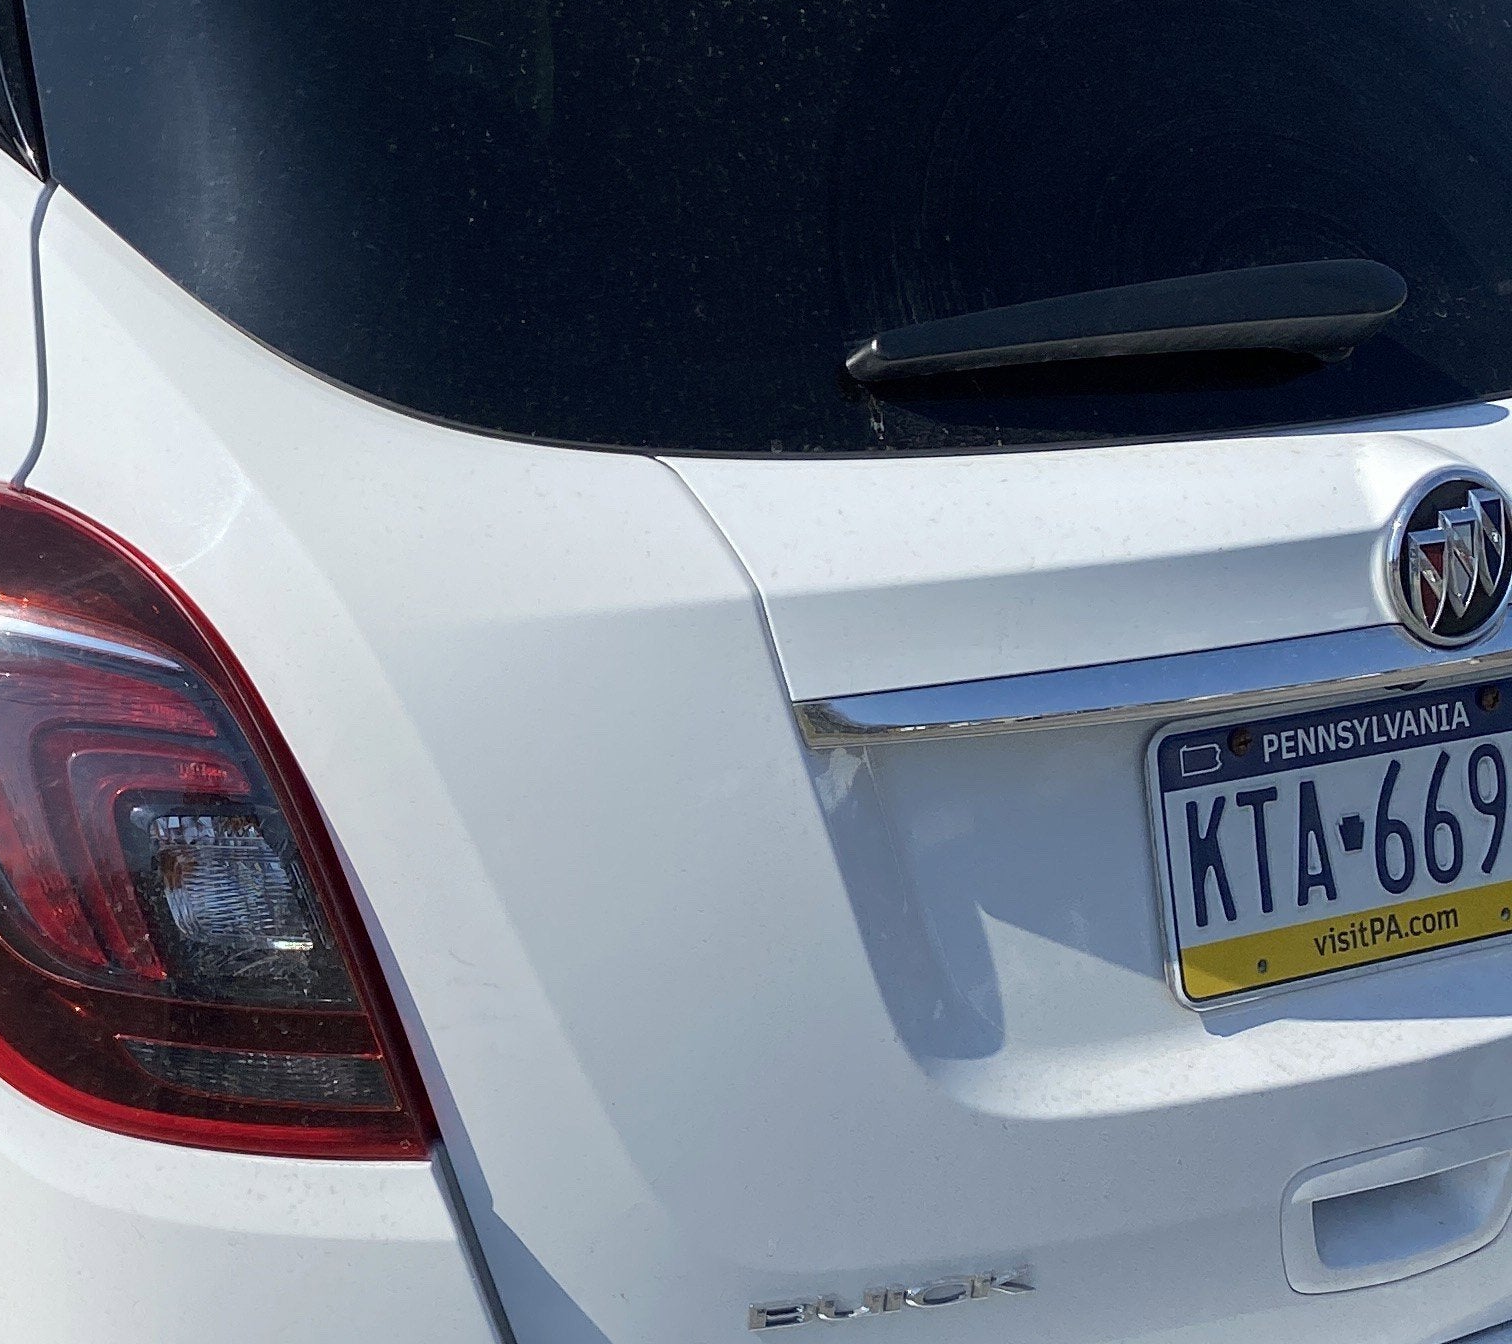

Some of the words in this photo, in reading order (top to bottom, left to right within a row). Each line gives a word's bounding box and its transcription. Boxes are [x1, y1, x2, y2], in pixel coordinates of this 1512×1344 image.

[1263, 701, 1470, 763] PENNSYLVANIA
[1313, 907, 1459, 956] visitPA.com
[748, 1264, 1036, 1332] BUICK
